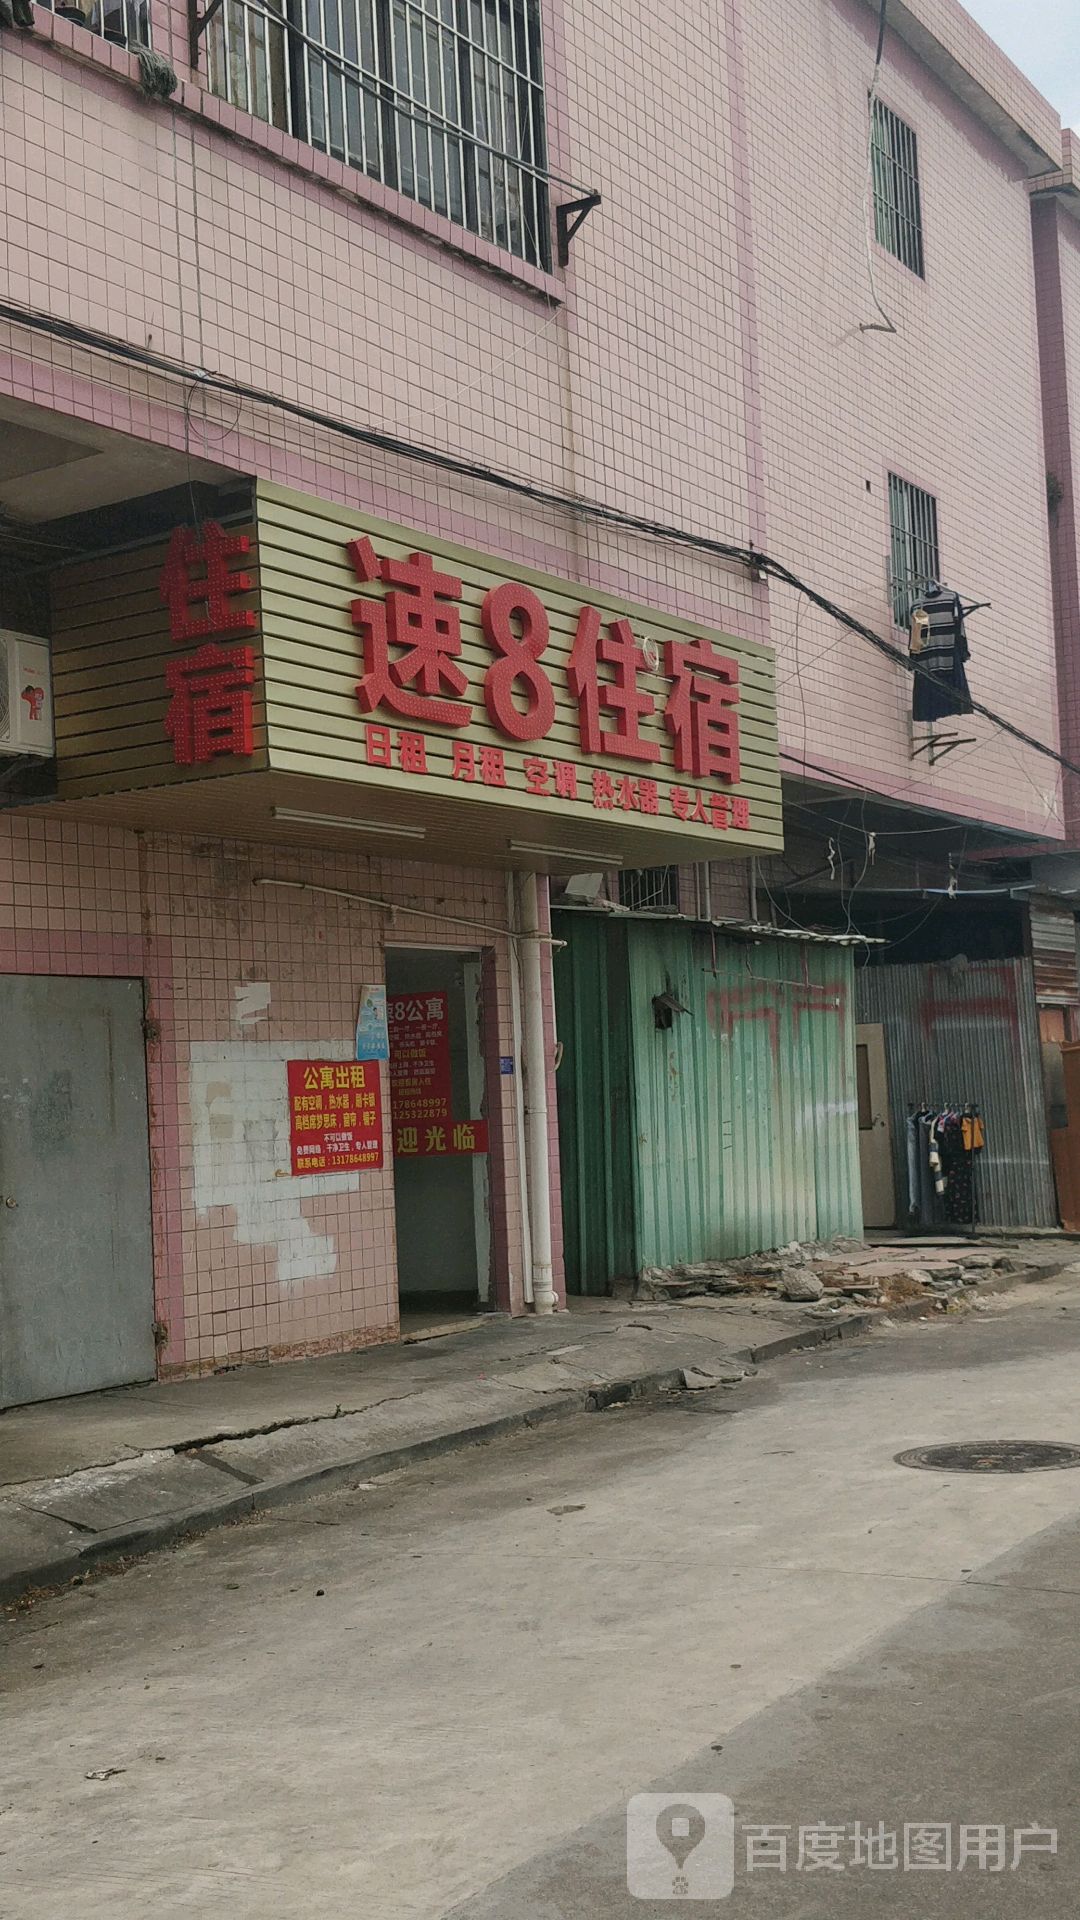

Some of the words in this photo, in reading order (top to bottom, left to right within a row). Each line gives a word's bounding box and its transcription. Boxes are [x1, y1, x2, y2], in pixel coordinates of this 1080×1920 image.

[160, 520, 256, 766] 住宿
[347, 534, 740, 784] 速8住宿
[365, 724, 429, 774] 日租
[452, 740, 506, 787] 月租
[524, 757, 578, 800] 空调
[592, 770, 660, 815] 热水器
[670, 786, 750, 830] 专人管理
[304, 1066, 365, 1090] 公寓出租
[397, 1124, 476, 1153] 迎光临
